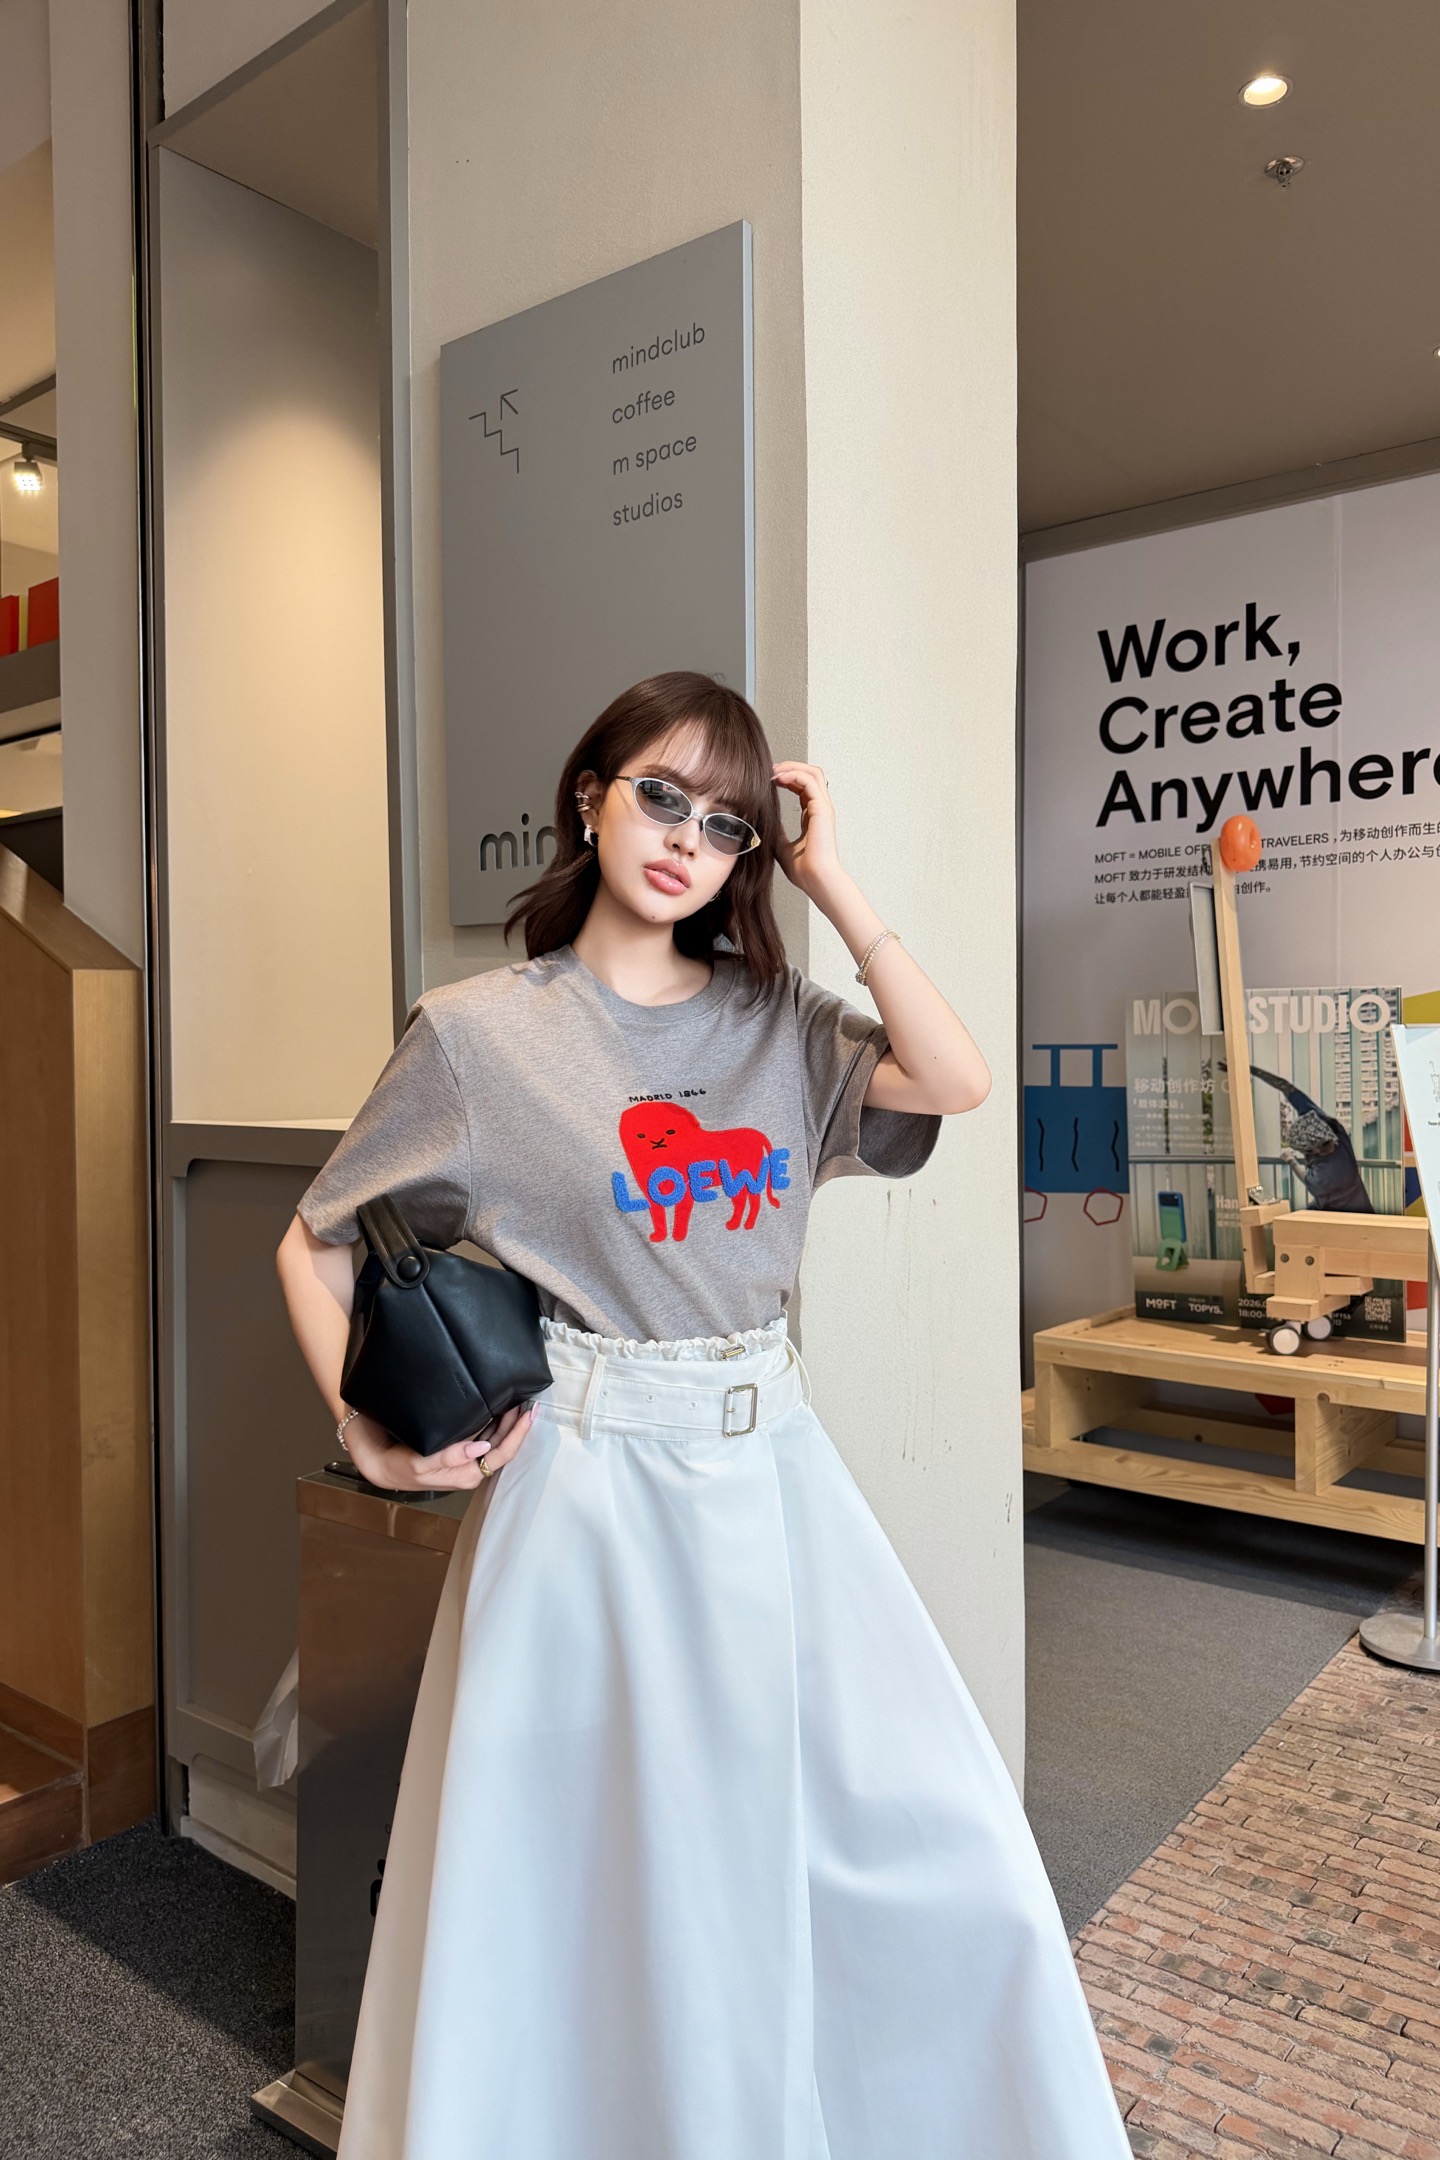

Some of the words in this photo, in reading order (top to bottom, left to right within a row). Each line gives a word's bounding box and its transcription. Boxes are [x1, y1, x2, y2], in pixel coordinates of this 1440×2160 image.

[612, 322, 706, 375] mindclub
[612, 389, 676, 424] coffee
[612, 456, 630, 476] m
[635, 435, 698, 471] space
[612, 492, 684, 527] studios
[1097, 601, 1300, 684] Work,
[1099, 678, 1343, 755] Create
[1095, 746, 1440, 833] Anywher
[1094, 852, 1126, 864] MOFT
[1138, 846, 1181, 860] MOBILE
[1260, 833, 1329, 849] TRAVELERS
[1094, 872, 1126, 884] MOFT
[1247, 993, 1391, 1035] STUDIO
[628, 1093, 673, 1103] MADRID
[678, 1088, 707, 1098] 1846
[1134, 1078, 1216, 1094] 移动创作坊
[611, 1147, 791, 1214] LOEWE
